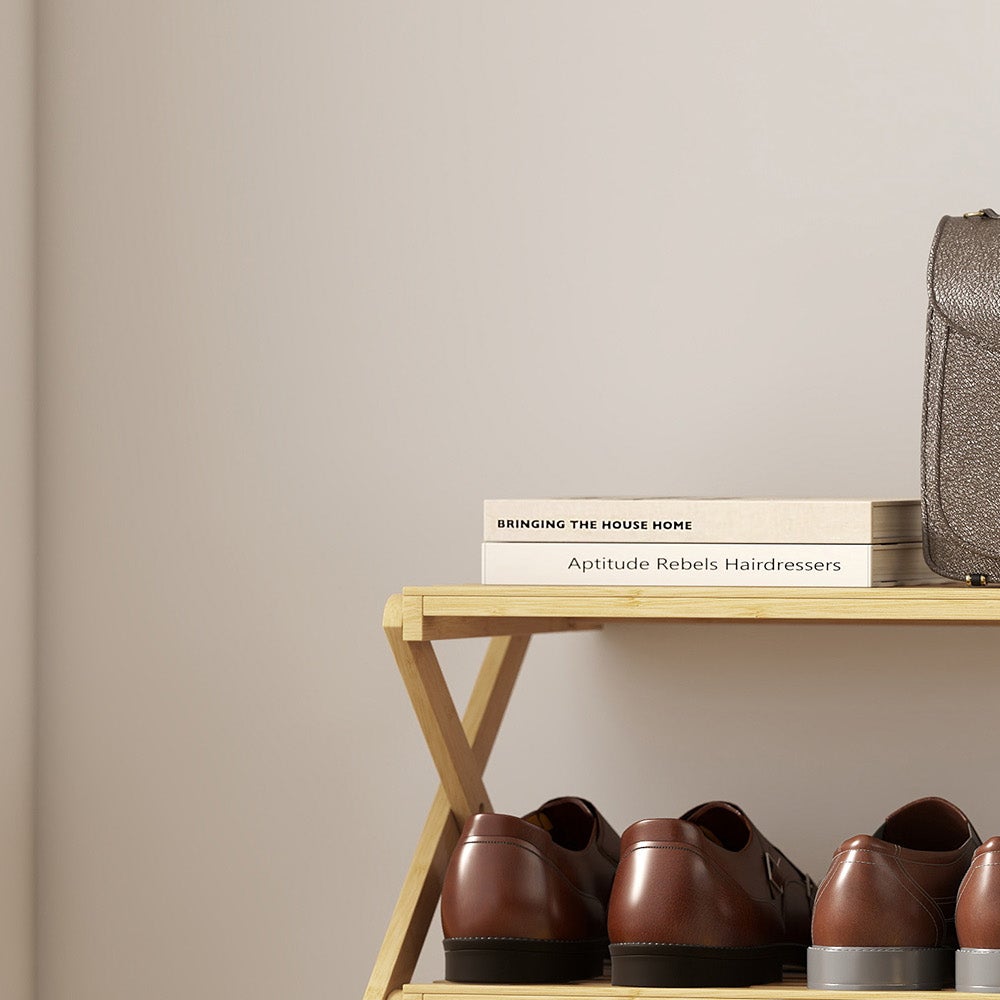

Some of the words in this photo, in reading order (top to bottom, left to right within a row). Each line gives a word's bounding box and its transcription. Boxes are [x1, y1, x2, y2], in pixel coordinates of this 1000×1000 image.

[497, 519, 566, 530] BRINGING
[570, 519, 598, 530] THE
[601, 520, 648, 531] HOUSE
[652, 520, 693, 531] HOME
[567, 556, 650, 574] Aptitude
[656, 556, 719, 572] Rebels
[724, 557, 842, 573] Hairdressers
